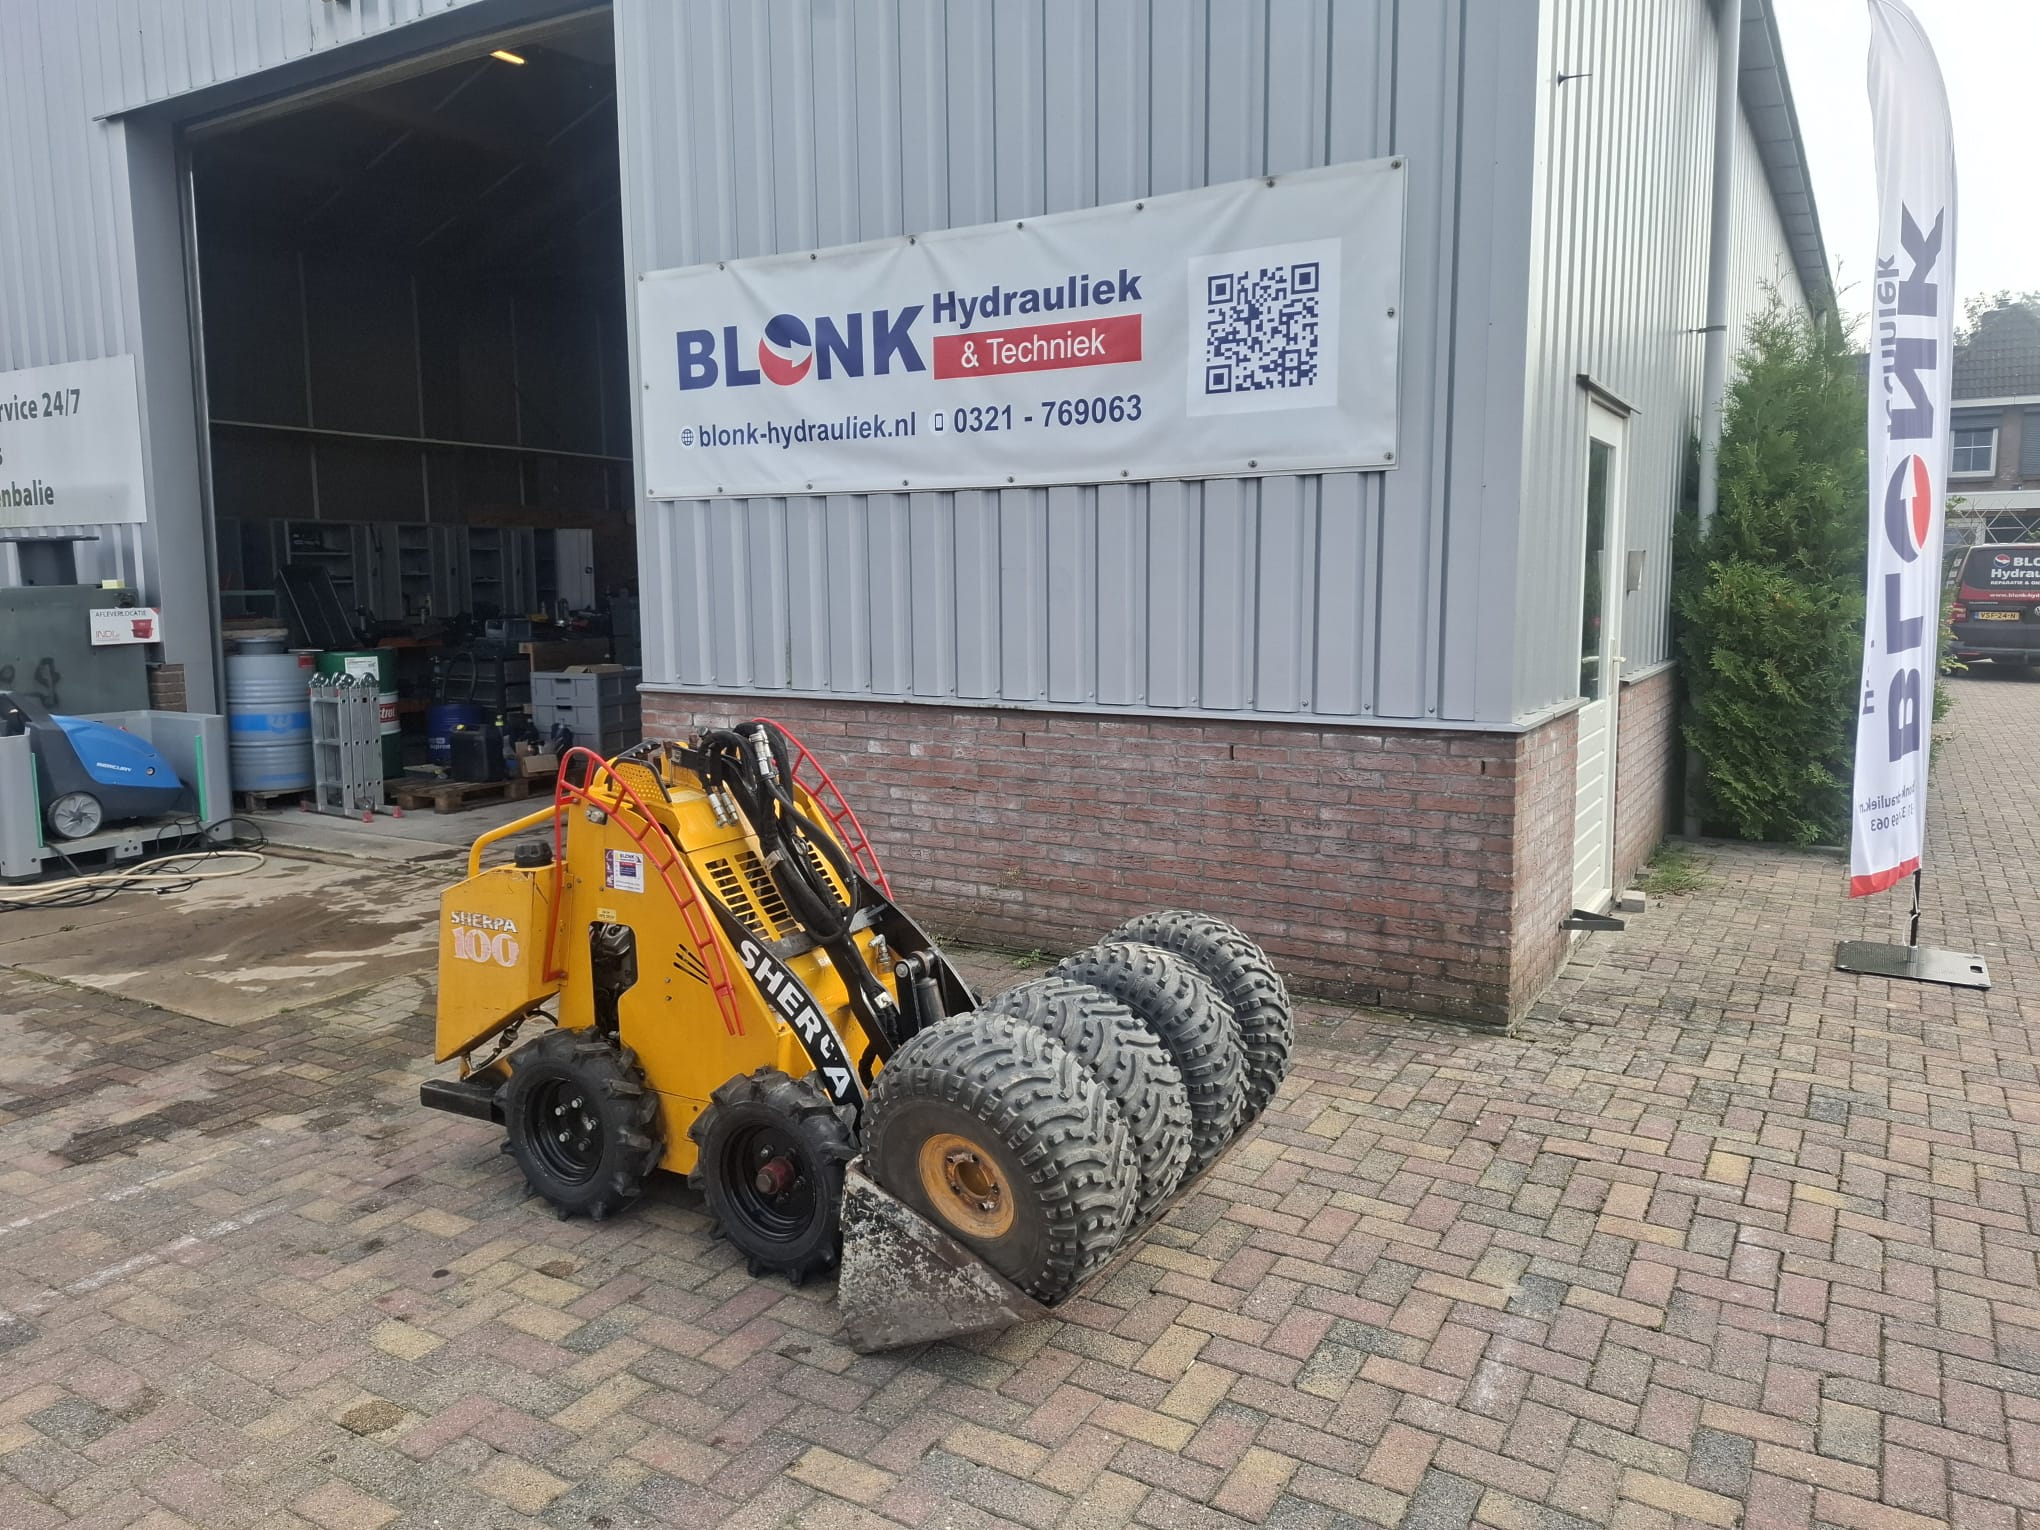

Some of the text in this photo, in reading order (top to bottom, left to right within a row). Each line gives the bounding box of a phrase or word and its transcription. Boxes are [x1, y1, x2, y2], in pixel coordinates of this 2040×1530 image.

[932, 268, 1143, 330] Hydrauliek
[676, 304, 927, 391] BLONK
[961, 327, 1106, 368] & Techniek
[41, 388, 80, 418] 24/7
[954, 404, 1012, 433] 0321
[1041, 394, 1142, 427] 769063
[699, 411, 916, 449] blonk-hydrauliek.nl
[0, 479, 54, 507] nbalie
[380, 706, 396, 719] trol
[451, 911, 518, 933] SHERPA
[452, 926, 520, 968] 100
